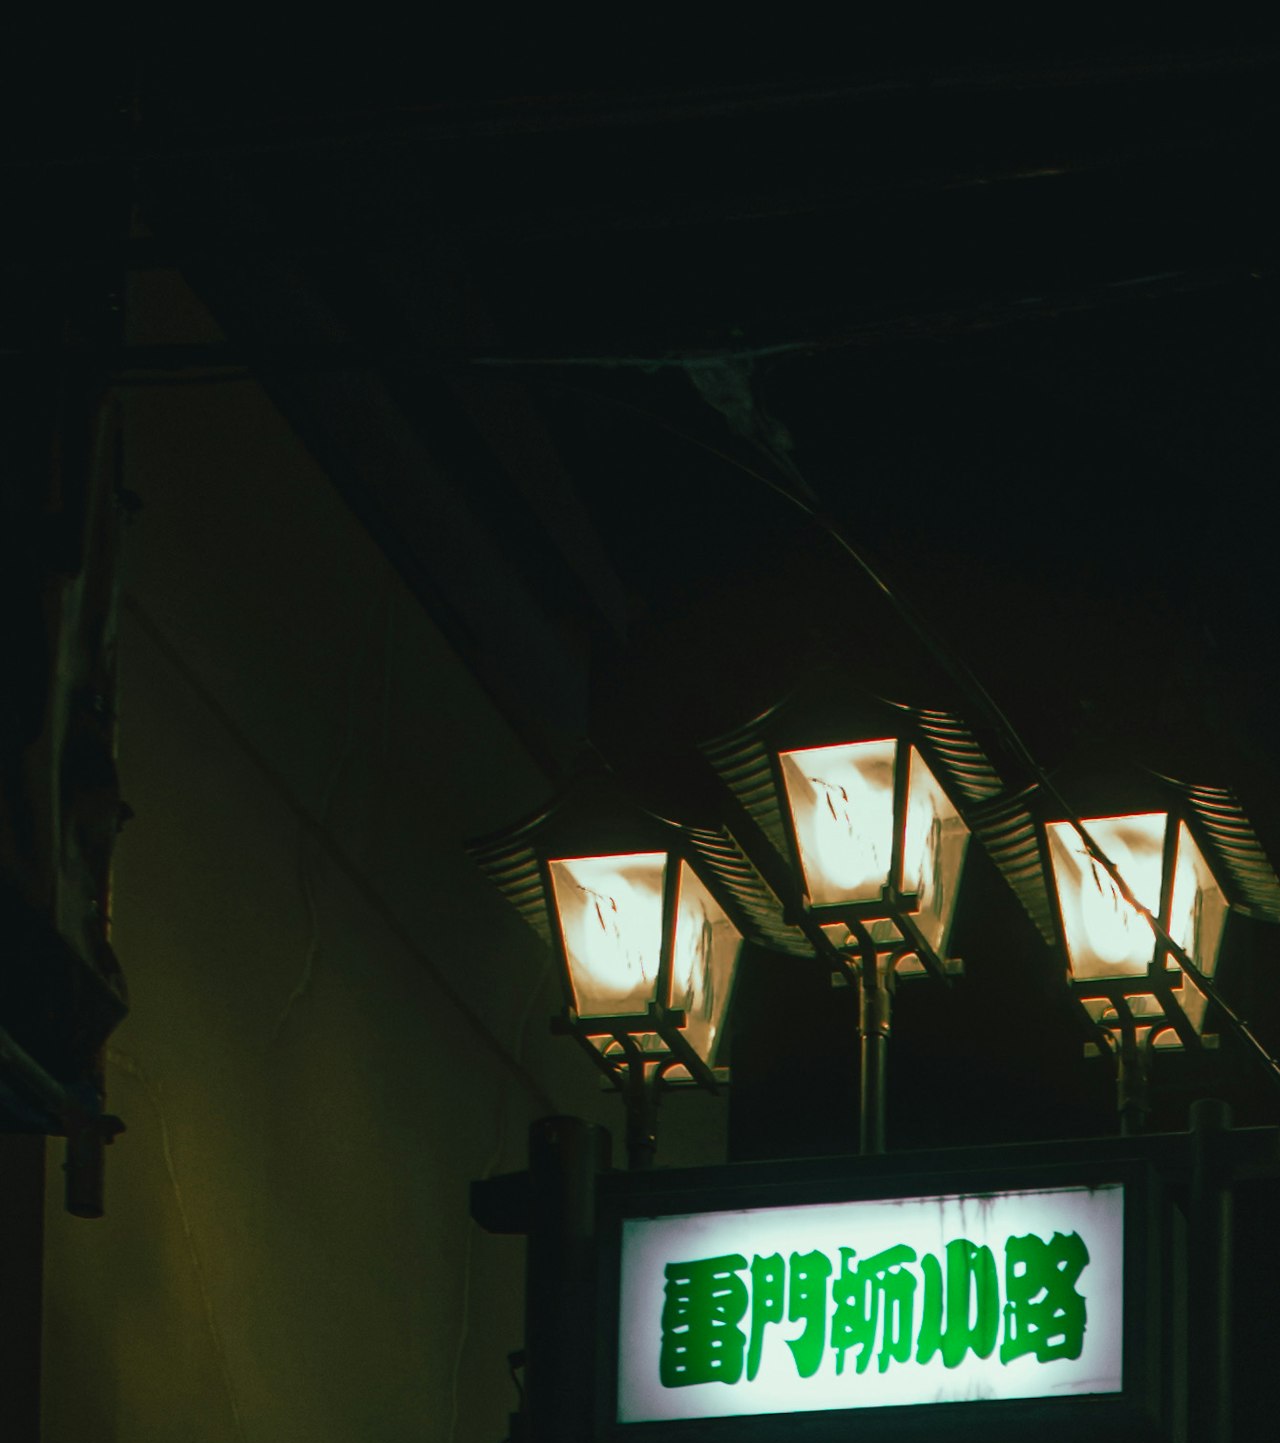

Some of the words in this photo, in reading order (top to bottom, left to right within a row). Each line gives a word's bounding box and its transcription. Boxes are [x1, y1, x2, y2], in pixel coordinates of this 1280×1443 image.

[660, 1230, 1089, 1388] 雷門柳小路
